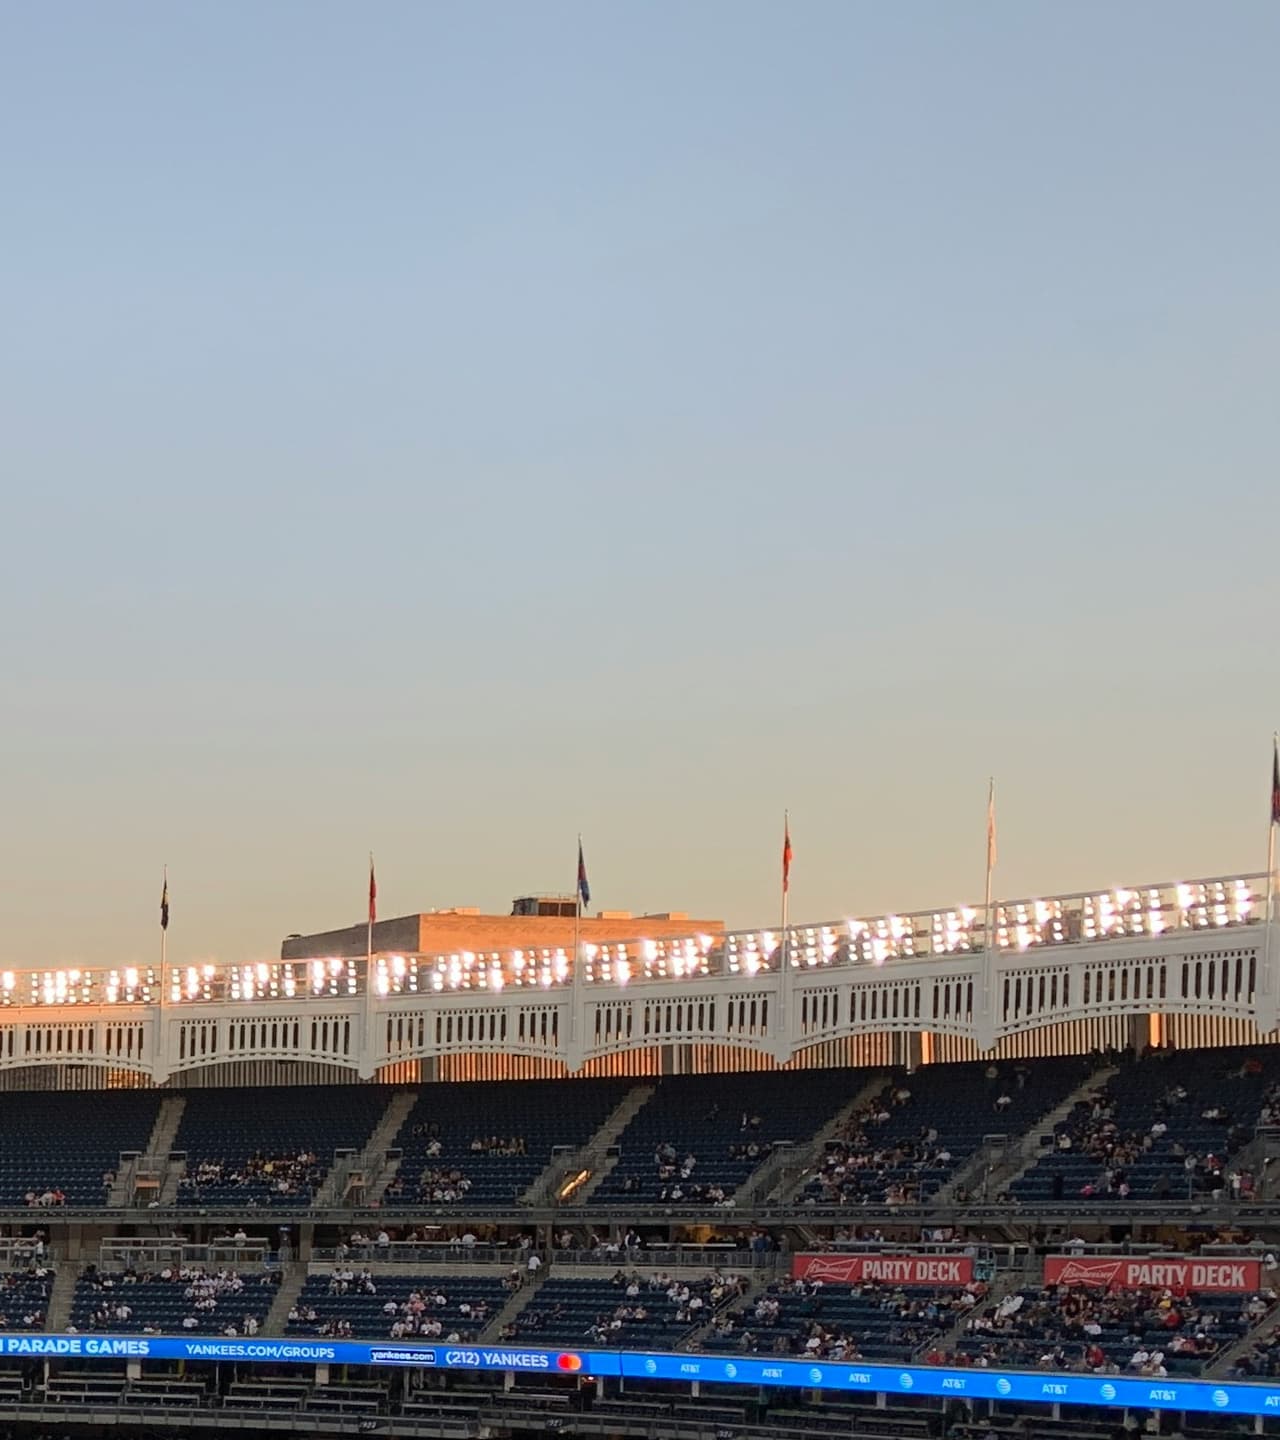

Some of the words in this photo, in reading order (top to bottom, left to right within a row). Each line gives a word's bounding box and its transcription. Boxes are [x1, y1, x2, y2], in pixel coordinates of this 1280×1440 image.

[862, 1260, 913, 1280] PARTY
[916, 1261, 960, 1281] DECK
[1127, 1264, 1188, 1285] PARTY
[1192, 1265, 1246, 1287] DECK
[8, 1338, 82, 1354] PARADE
[85, 1339, 150, 1355] GAMES
[186, 1343, 335, 1359] YANKEES.COM/GROUPS
[371, 1350, 434, 1362] yankees.com
[446, 1351, 481, 1366] (212)
[484, 1352, 549, 1368] YANKEES
[681, 1364, 700, 1374] AT&T
[762, 1368, 783, 1379] AT&T
[849, 1373, 872, 1384] AT&T
[942, 1378, 967, 1390] AT&T
[1042, 1384, 1069, 1395] AT&T
[1149, 1390, 1177, 1401] AT&T
